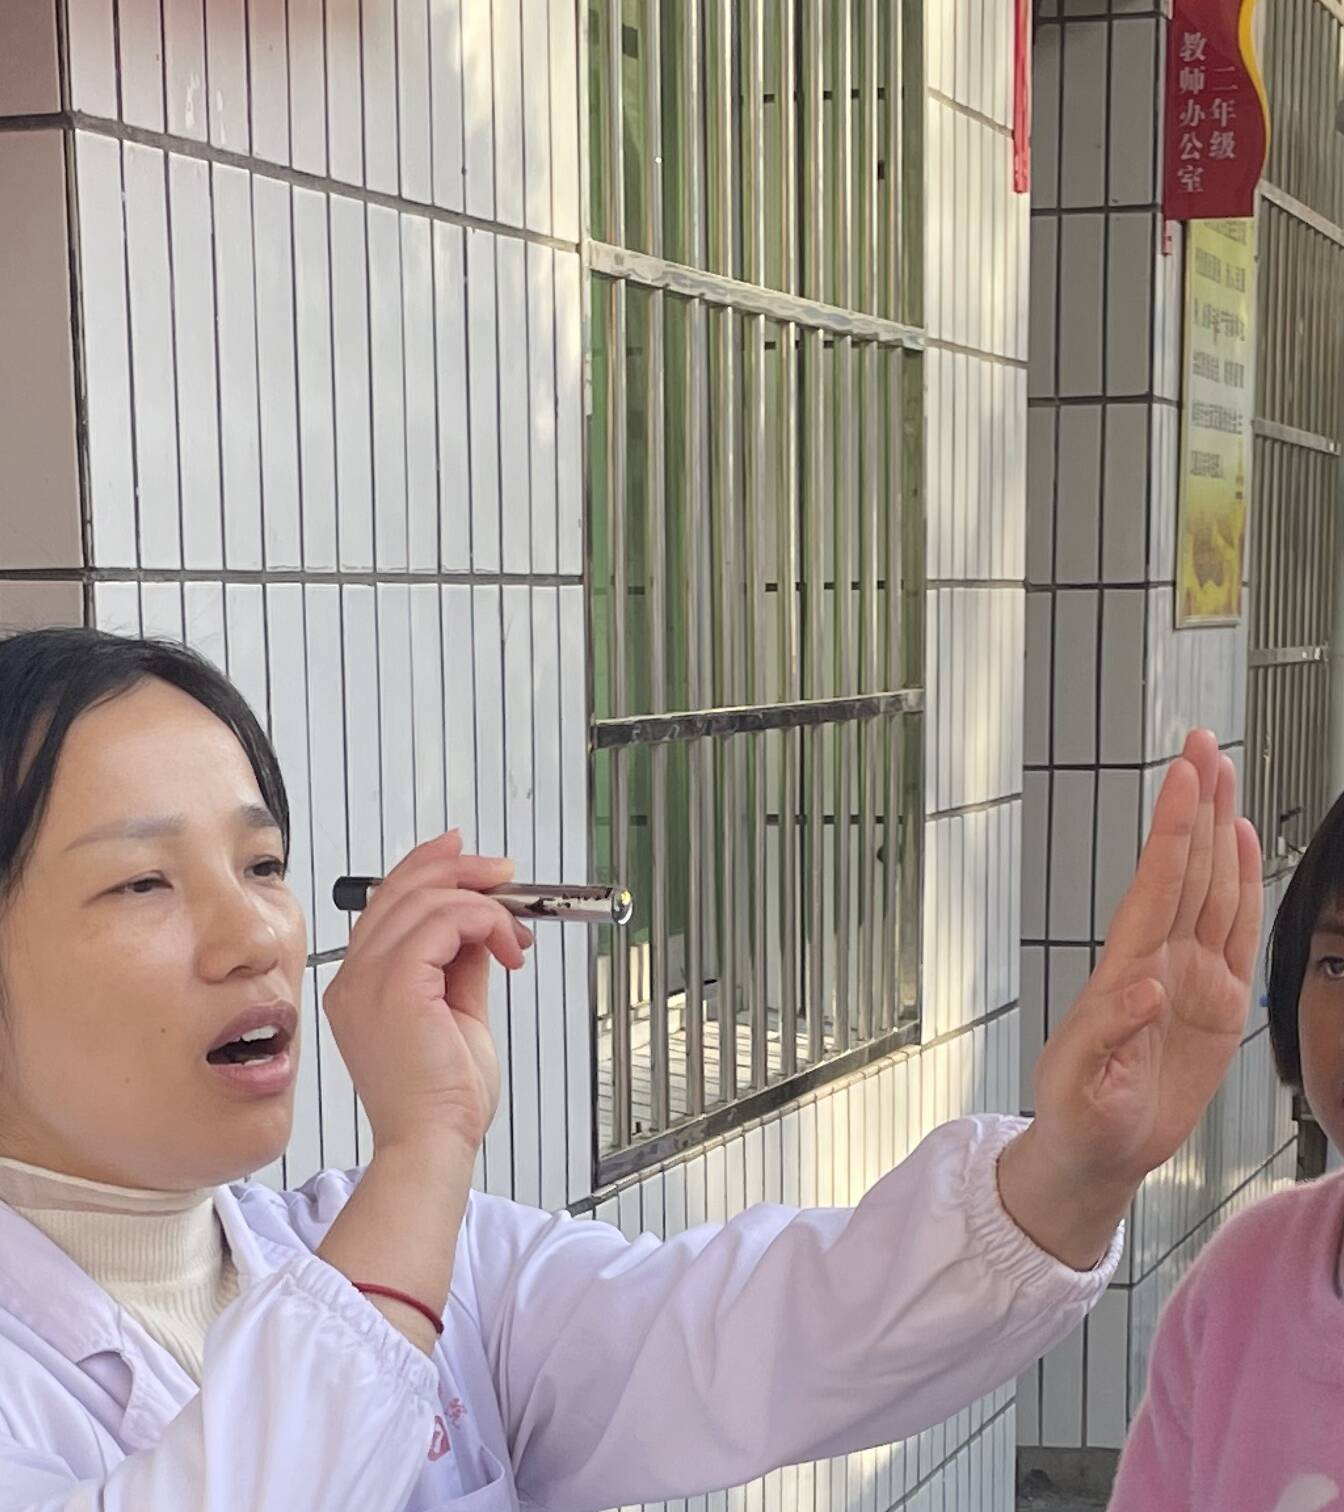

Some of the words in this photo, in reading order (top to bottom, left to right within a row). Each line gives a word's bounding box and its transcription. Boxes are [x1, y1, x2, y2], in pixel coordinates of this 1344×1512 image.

[1177, 32, 1208, 193] 教师办公室
[1208, 66, 1238, 159] 二年级
